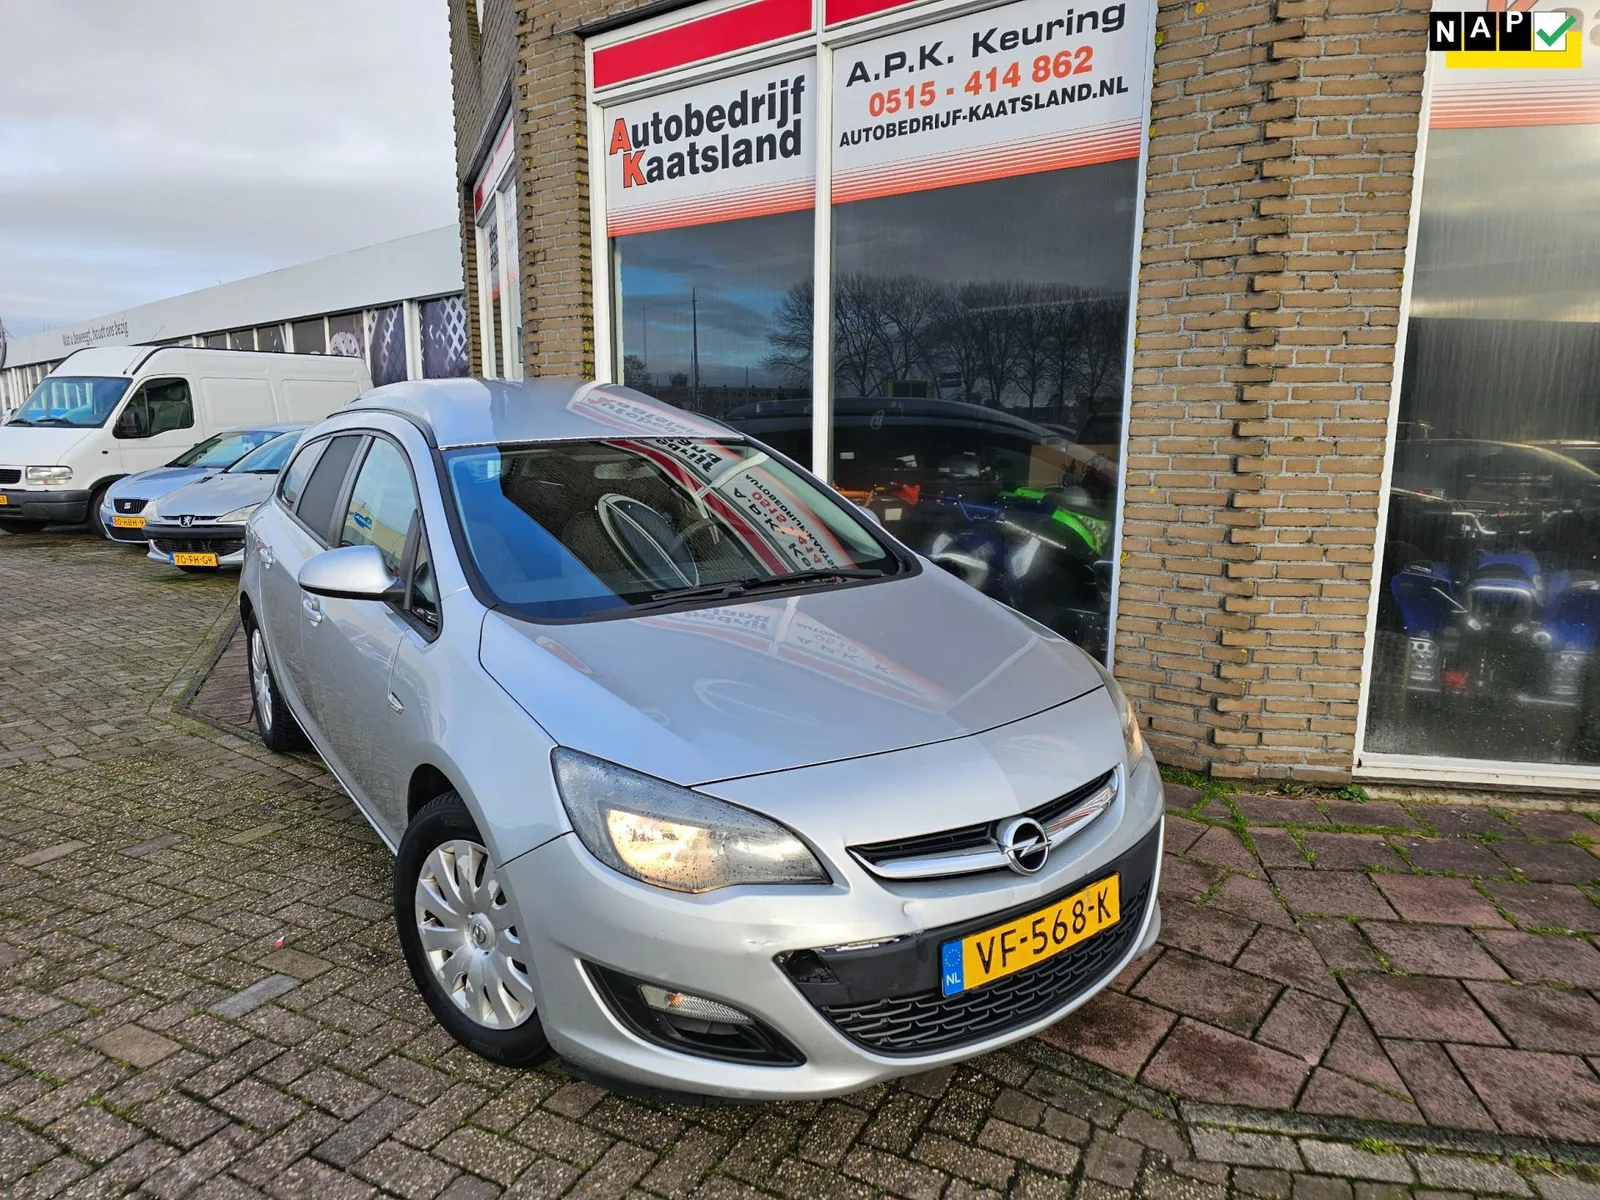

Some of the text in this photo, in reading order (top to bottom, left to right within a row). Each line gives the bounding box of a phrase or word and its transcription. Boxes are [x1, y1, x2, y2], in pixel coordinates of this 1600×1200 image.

[846, 3, 1125, 87] A.P.K. Keuring
[868, 80, 936, 117] 0515
[964, 61, 1021, 96] 414
[1032, 45, 1094, 83] 862
[609, 75, 805, 155] Autobedrijf
[839, 75, 1128, 147] AUTOBEDRIJF-KAATSLAND.NL
[623, 118, 801, 188] Kaatsland
[176, 555, 214, 566] 70-FH-GR
[976, 886, 1112, 975] VF-568-K
[946, 972, 961, 987] NL
